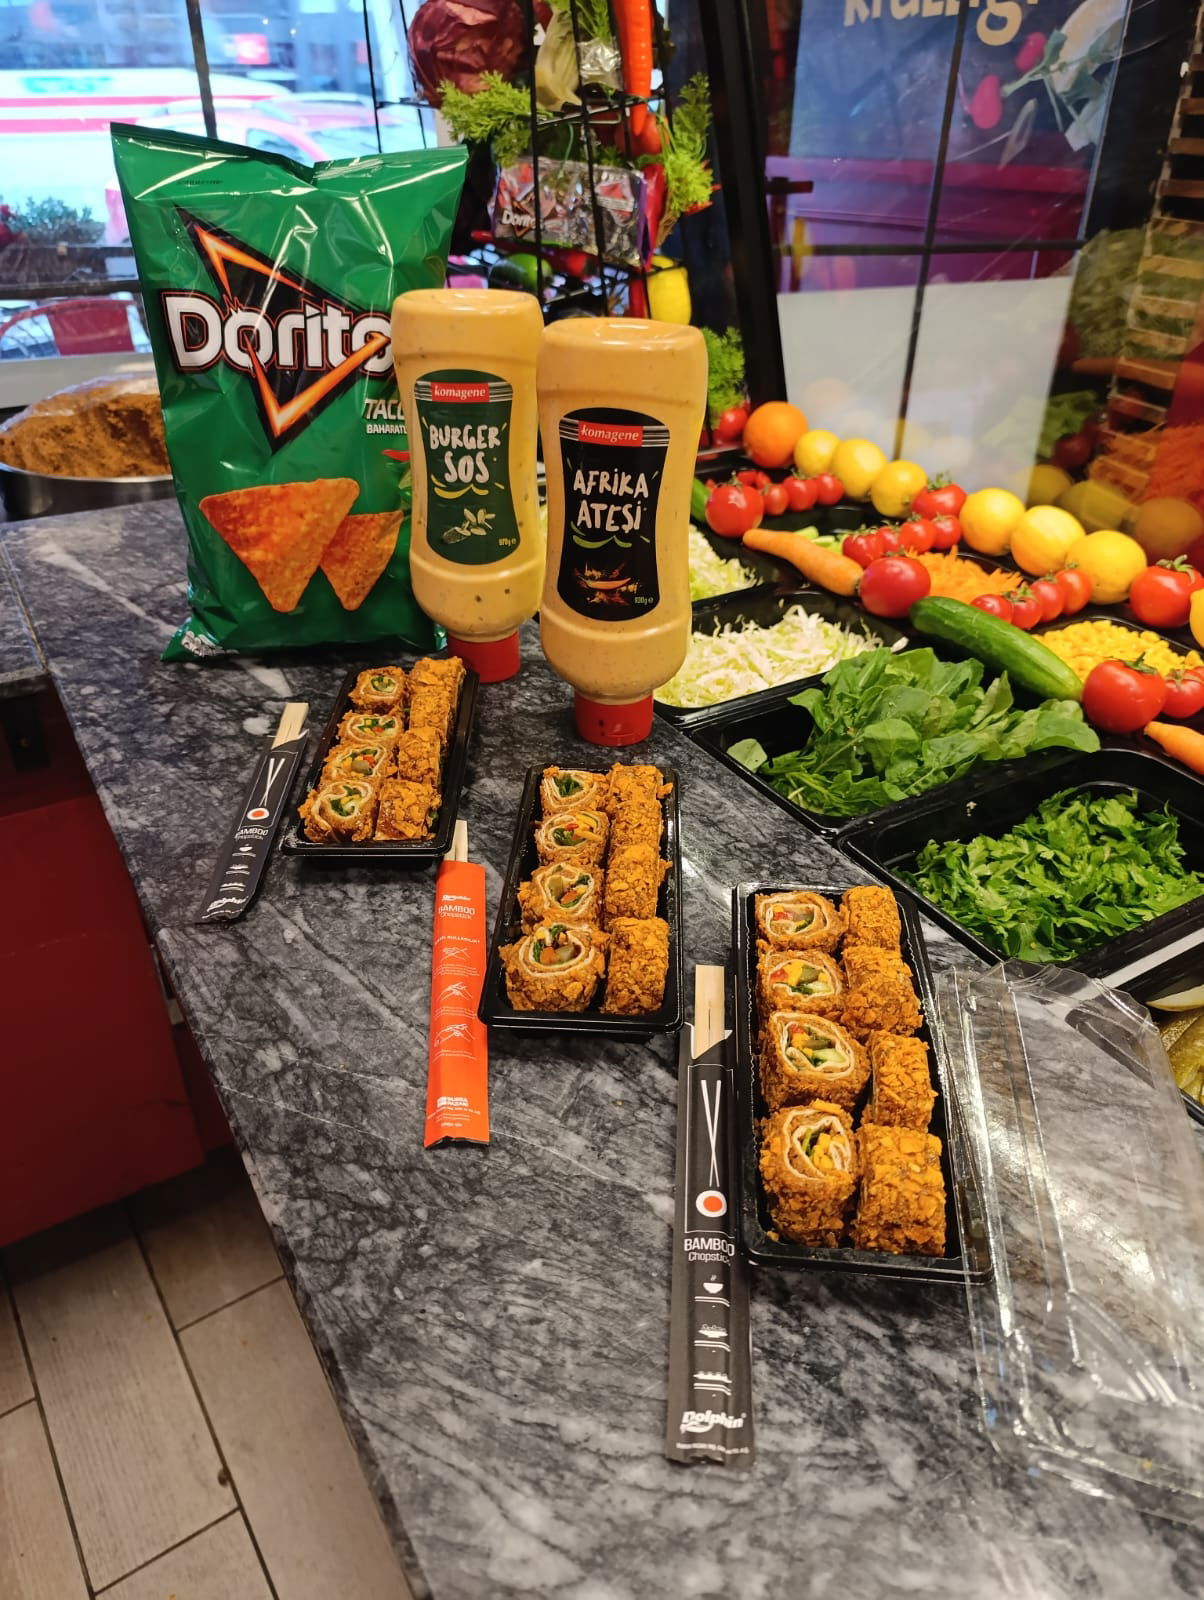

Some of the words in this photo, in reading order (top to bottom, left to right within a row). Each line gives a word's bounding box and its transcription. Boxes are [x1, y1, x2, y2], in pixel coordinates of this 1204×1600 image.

[162, 292, 393, 374] Dorito
[434, 385, 486, 400] komagene
[366, 424, 407, 434] BAHARATL
[429, 424, 501, 450] BURGER
[581, 424, 639, 443] komagene
[444, 451, 490, 483] SOS
[573, 468, 649, 498] AFRİKA
[577, 500, 642, 533] ATEŞİ
[684, 1237, 735, 1257] BAMBOO
[681, 1410, 744, 1429] Dolphin
